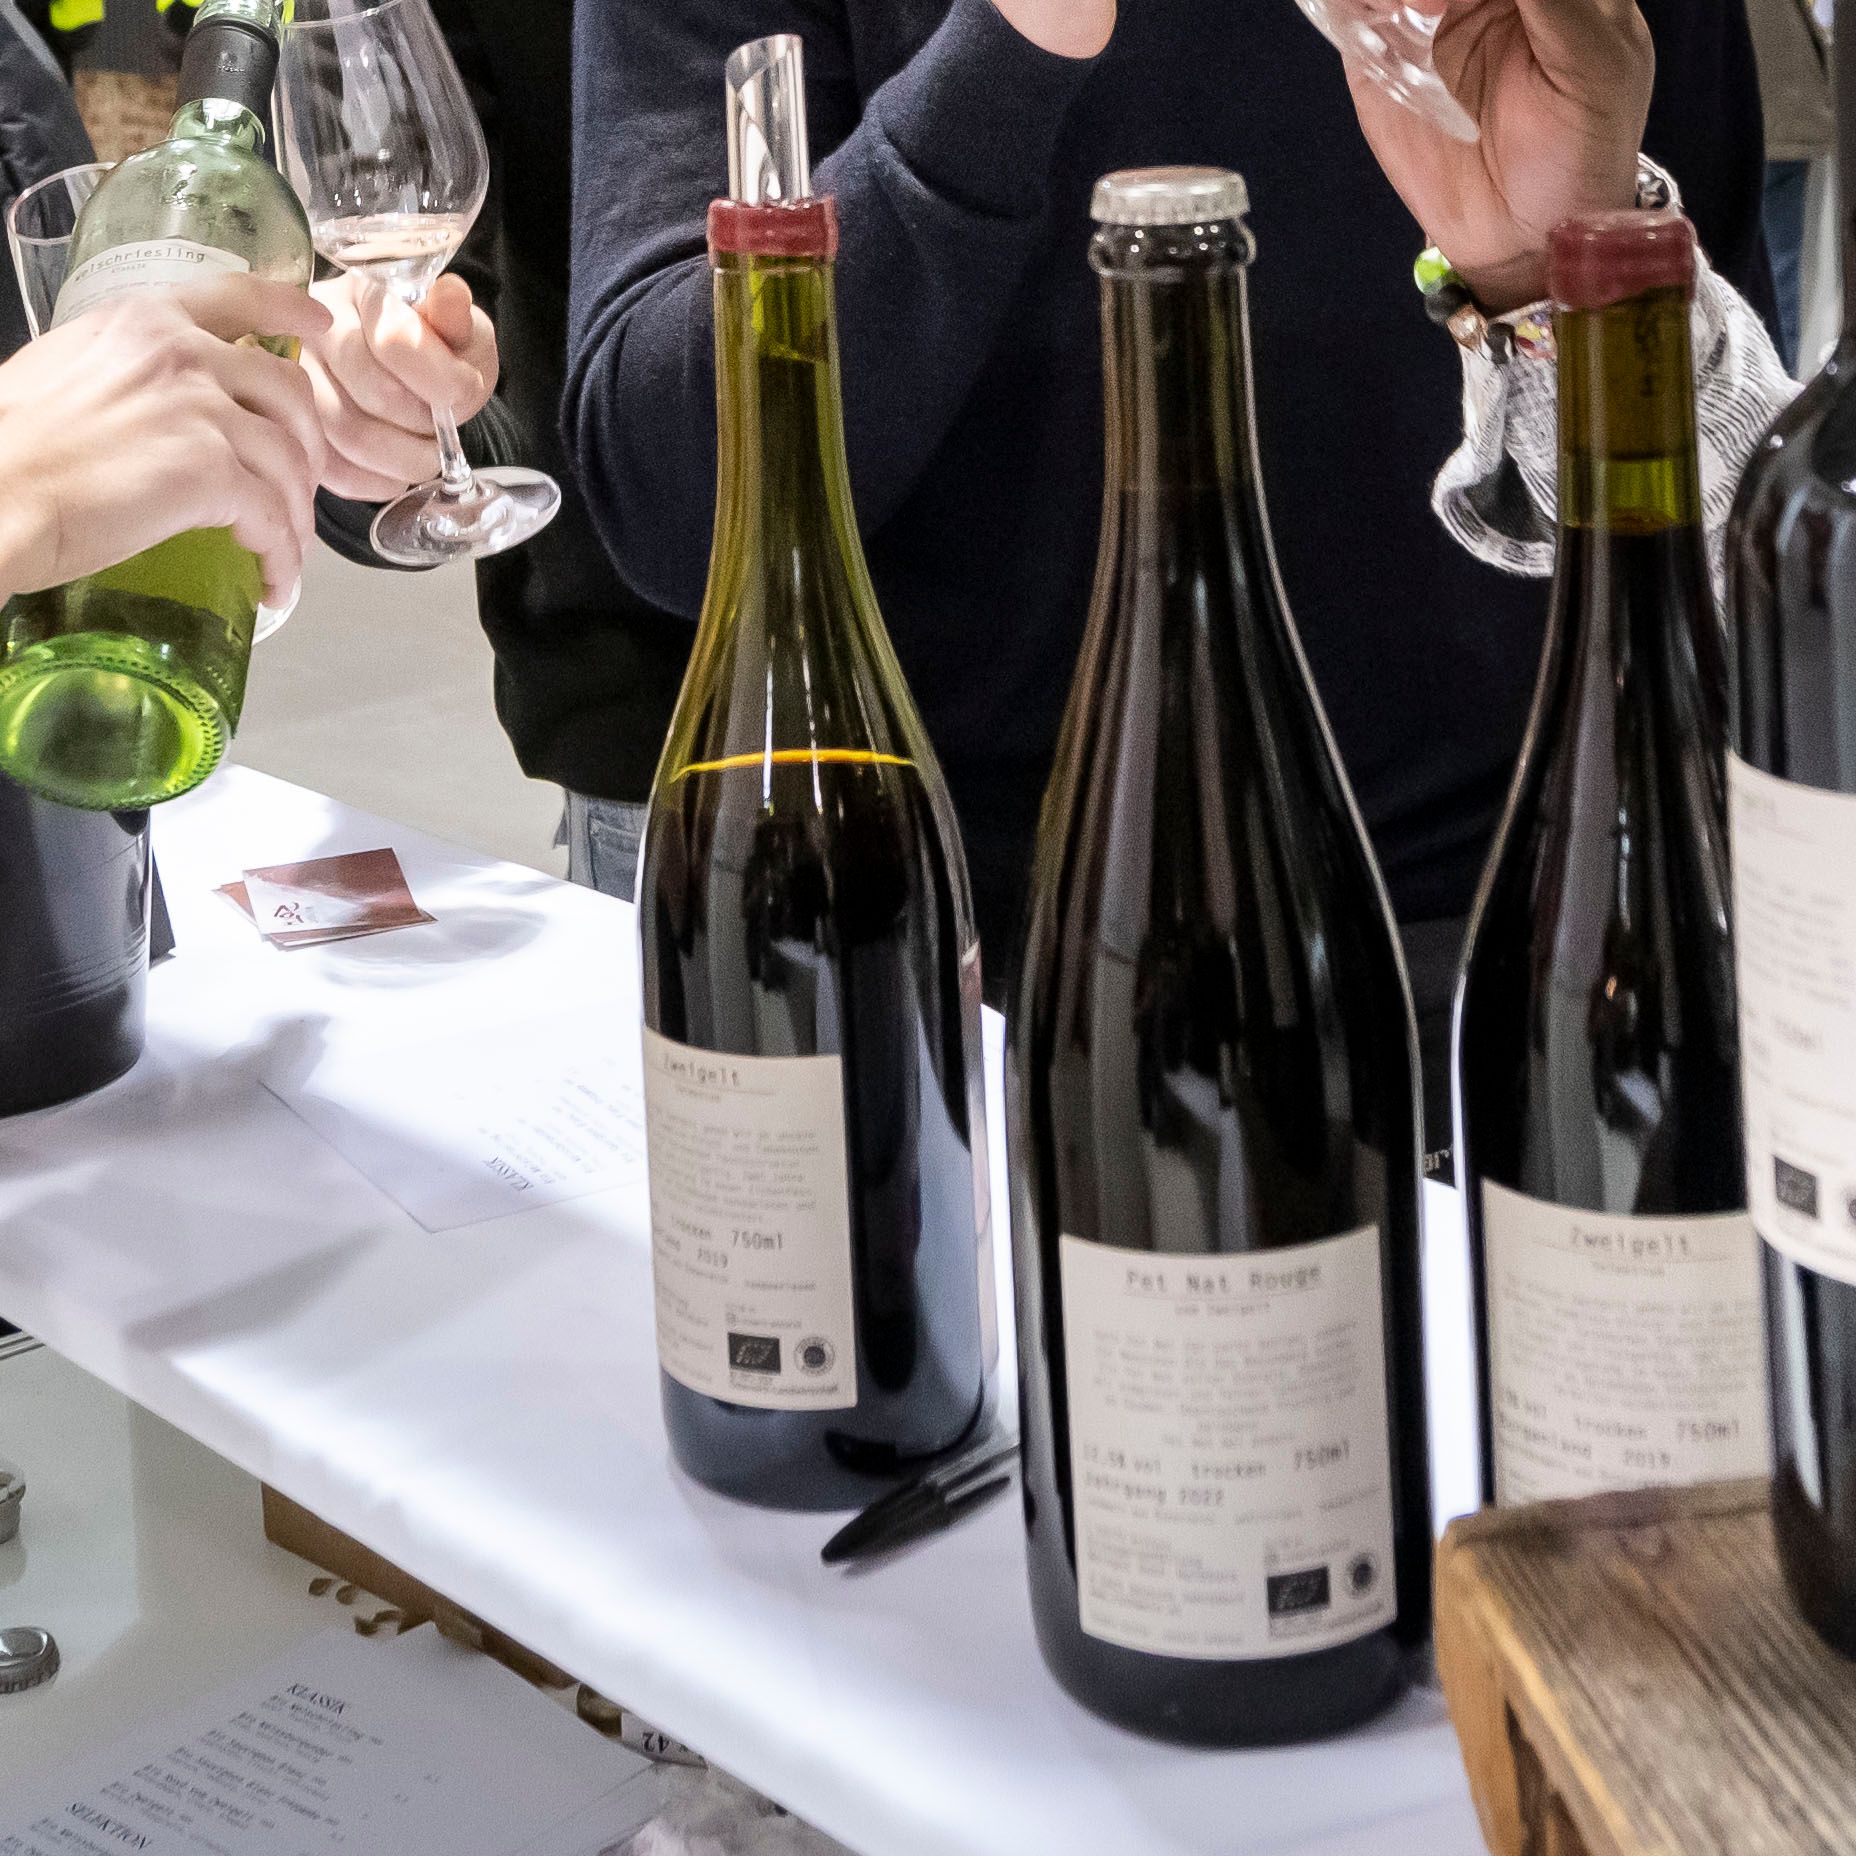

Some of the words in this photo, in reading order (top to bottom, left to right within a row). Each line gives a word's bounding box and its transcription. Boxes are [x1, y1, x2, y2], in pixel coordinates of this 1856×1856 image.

[731, 1229, 784, 1250] 750ml
[1126, 1269, 1167, 1293] Pet
[1186, 1271, 1230, 1294] Nat
[1249, 1265, 1322, 1291] Rouge
